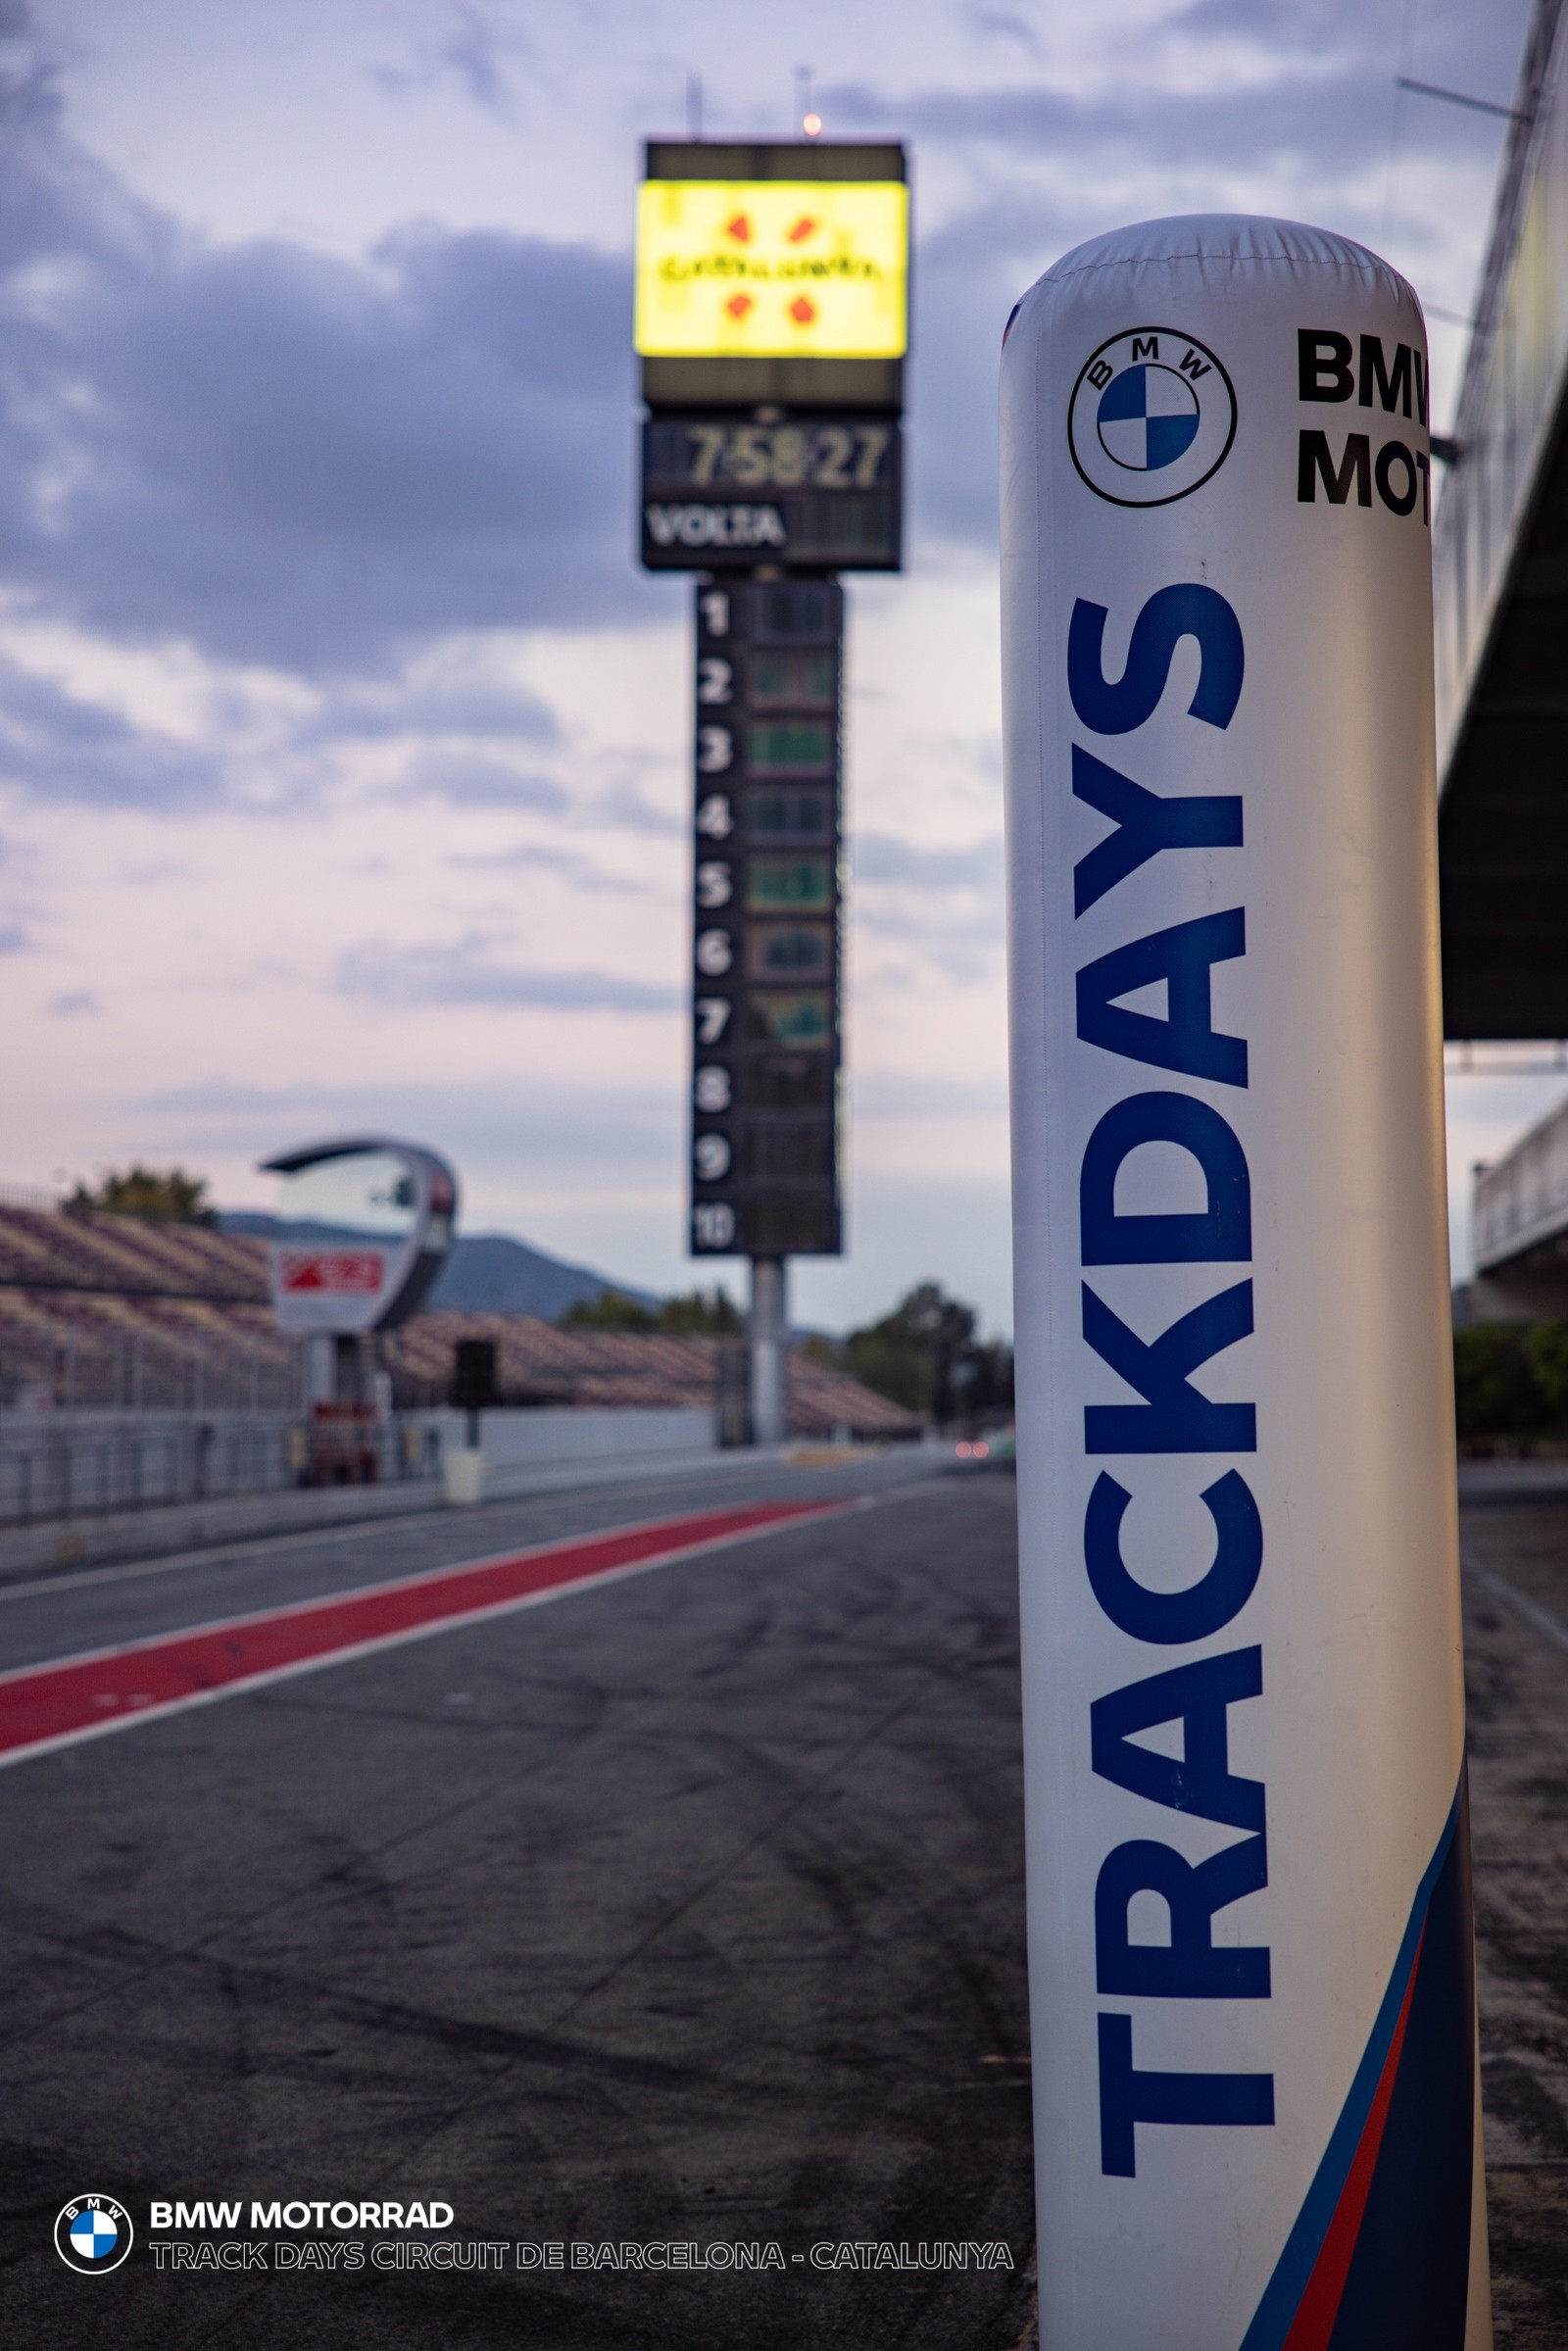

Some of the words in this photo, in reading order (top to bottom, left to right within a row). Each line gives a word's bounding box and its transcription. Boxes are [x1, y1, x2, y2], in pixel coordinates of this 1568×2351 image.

[1087, 336, 1212, 391] BMW
[648, 506, 784, 545] VOLTA
[702, 592, 728, 635] 1
[700, 658, 732, 704] 2
[700, 726, 732, 772] 3
[697, 795, 732, 839] 4
[698, 861, 732, 907] 5
[696, 929, 732, 975] 6
[698, 998, 730, 1044] 7
[696, 1066, 730, 1112] 8
[695, 1135, 730, 1180] 9
[694, 1202, 734, 1248] 10
[1066, 582, 1274, 2179] TRACKDAYS
